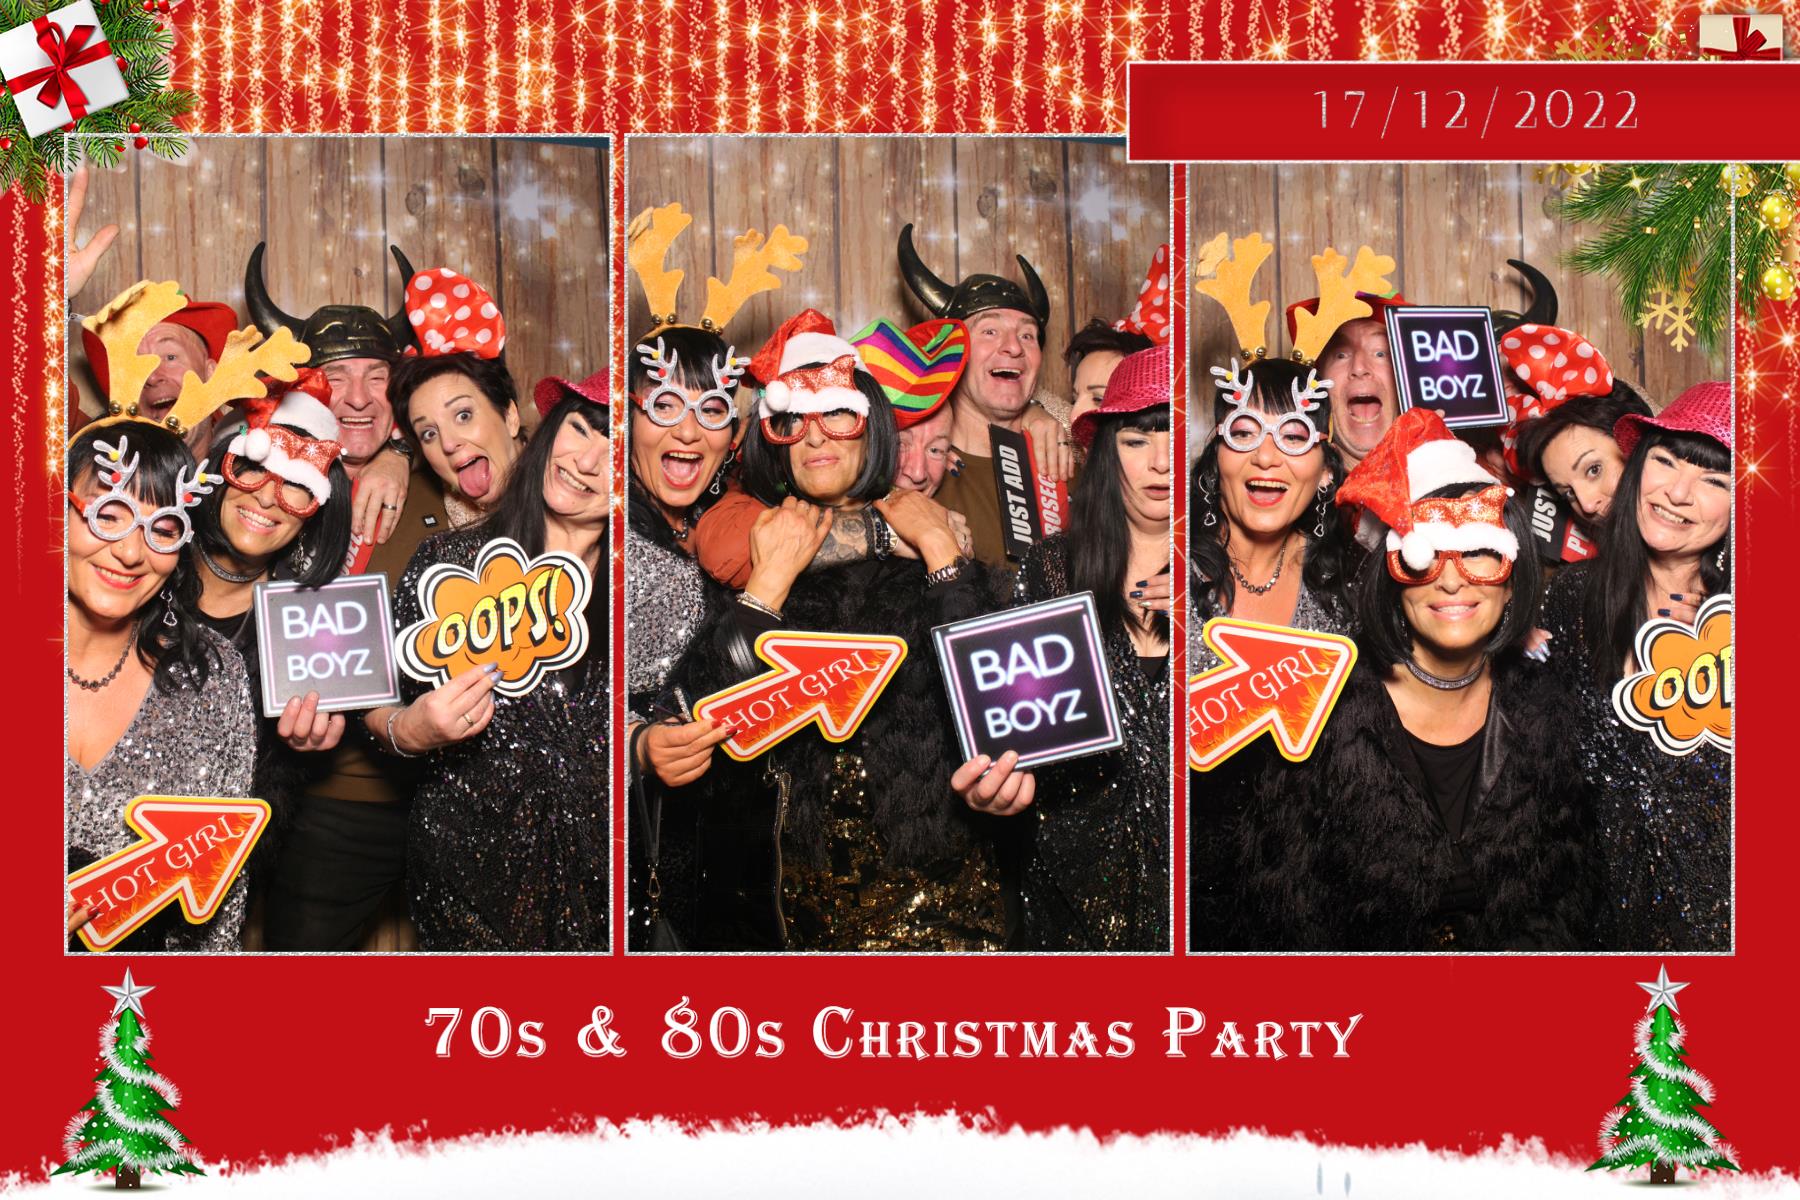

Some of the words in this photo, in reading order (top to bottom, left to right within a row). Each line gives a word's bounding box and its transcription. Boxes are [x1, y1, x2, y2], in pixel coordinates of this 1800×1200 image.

[1411, 330, 1479, 362] BAD
[1419, 374, 1487, 401] BOYZ
[998, 444, 1025, 491] ADD
[1006, 489, 1034, 546] JUST
[282, 601, 367, 640] BAD
[434, 563, 566, 657] OOPS!
[287, 649, 373, 682] BOYZ
[970, 634, 1075, 692] BAD
[722, 685, 794, 735] HOT
[799, 650, 882, 697] GIRL
[985, 688, 1088, 739] BOYZ
[1190, 683, 1246, 737] HOT
[1249, 648, 1332, 701] GIRL
[83, 858, 159, 919] HOT
[165, 815, 245, 870] GIRL
